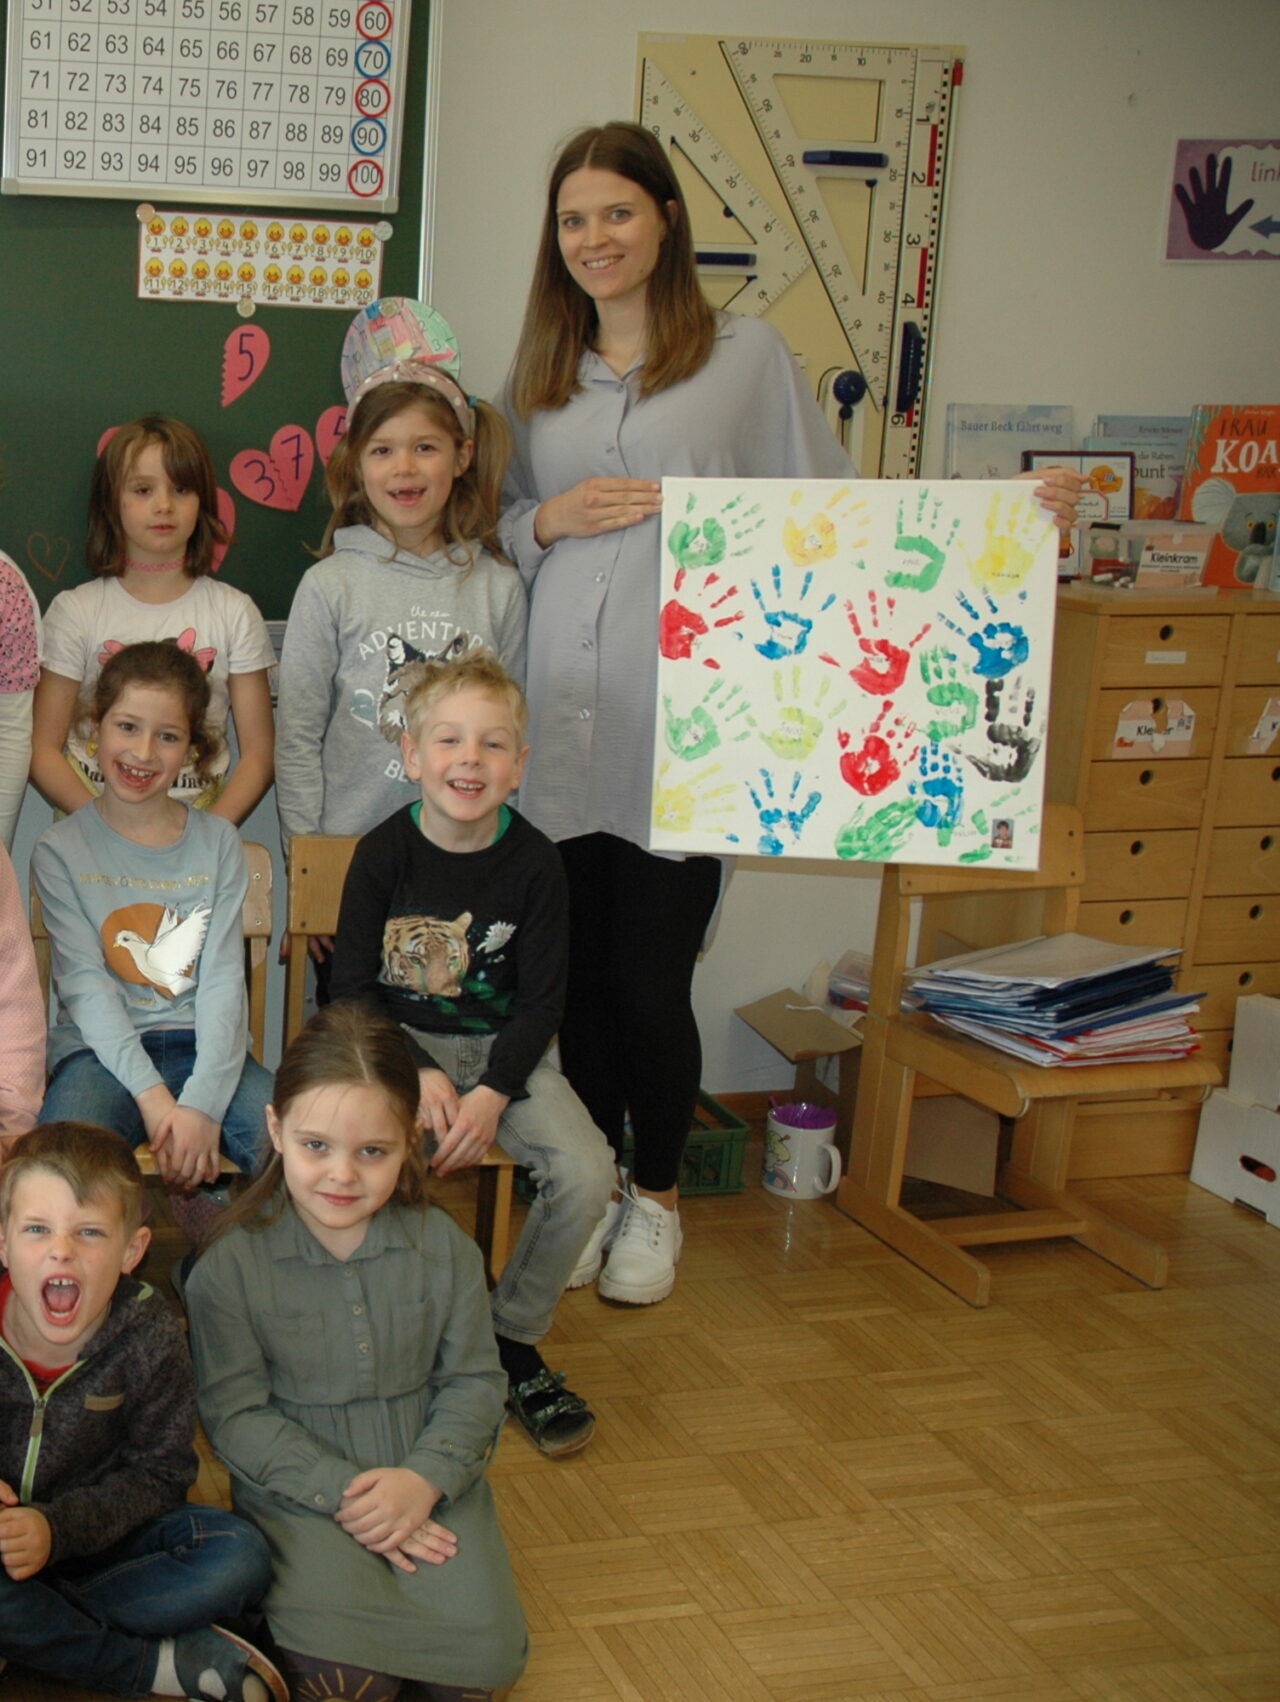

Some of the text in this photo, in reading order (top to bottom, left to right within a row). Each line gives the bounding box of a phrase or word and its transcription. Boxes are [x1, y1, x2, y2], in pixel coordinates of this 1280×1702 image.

[107, 0, 130, 15] 53
[144, 0, 167, 17] 54
[182, 0, 205, 19] 55
[218, 1, 242, 22] 56
[255, 3, 279, 23] 57
[292, 6, 315, 26] 58
[328, 8, 351, 29] 59
[364, 11, 386, 31] 60
[30, 30, 384, 70] 61 62 63 64 65 66 67 68 69 70
[800, 54, 812, 64] 20
[29, 69, 382, 108] 71 72 73 74 75 76 77 78 79 80
[27, 109, 379, 146] 81 82 83 84 85 86 87 88 89 90
[26, 148, 380, 184] 91 92 93 94 95 96 97 98 99 100
[889, 168, 897, 182] 20
[911, 172, 926, 184] 2
[883, 229, 892, 243] 30
[906, 233, 921, 246] 3
[361, 249, 372, 258] 10
[149, 279, 369, 299] 11 12 13 14 15 16 17 18 19 20
[877, 290, 885, 304] 40
[901, 293, 915, 306] 4
[237, 333, 255, 381] 5
[872, 351, 880, 364] 50
[960, 421, 988, 432] Bauer
[991, 421, 1013, 432] Beck
[1043, 424, 1063, 434] weg
[1210, 439, 1280, 474] KOA
[244, 434, 304, 501] 3 7
[1150, 552, 1198, 563] Kleinkram
[1136, 726, 1174, 736] Kler
